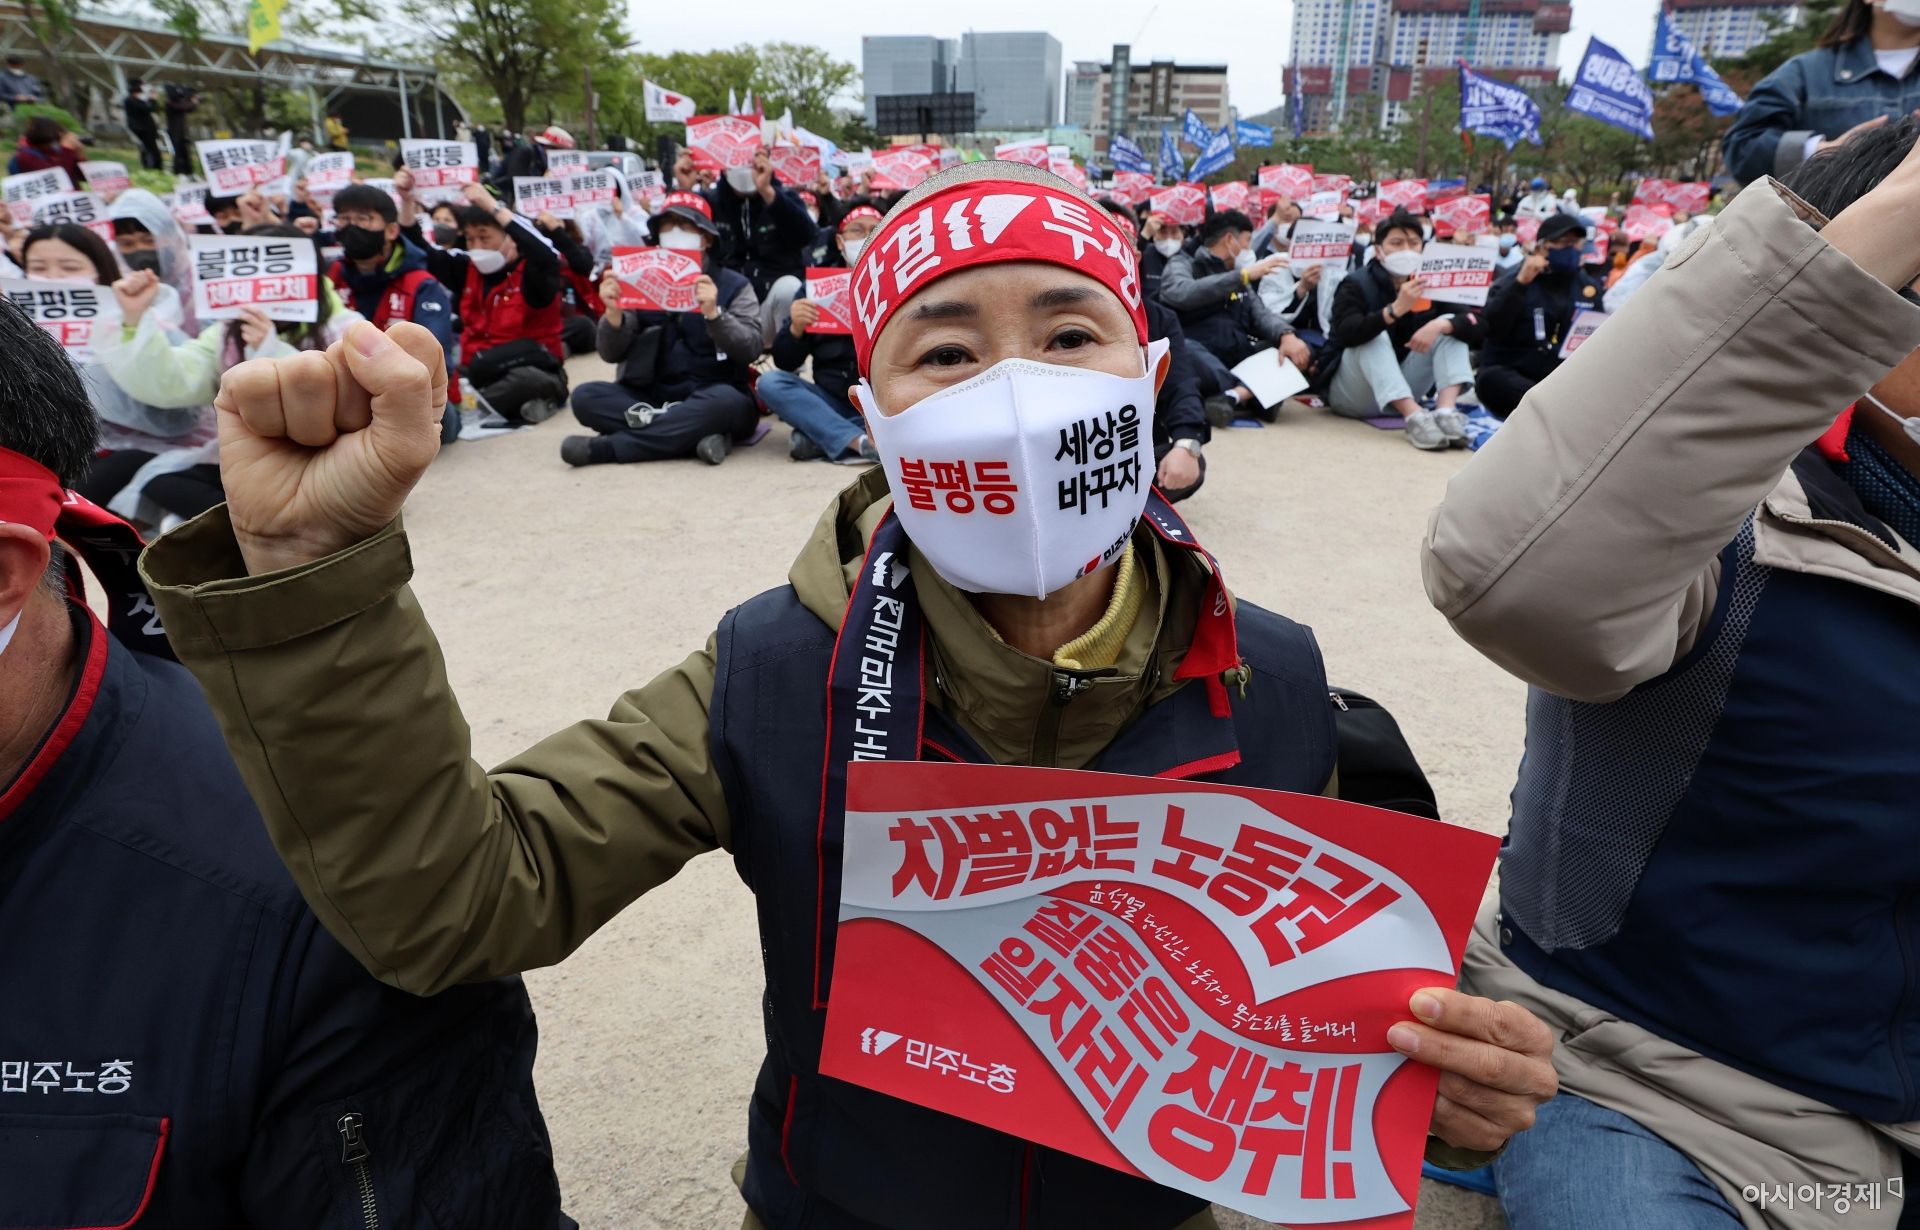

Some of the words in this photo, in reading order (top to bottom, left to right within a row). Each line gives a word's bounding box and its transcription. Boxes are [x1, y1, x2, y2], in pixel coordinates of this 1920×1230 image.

[407, 146, 462, 168] 불평등
[197, 243, 294, 280] 불평등
[257, 276, 307, 301] 교체
[854, 206, 942, 340] 단결
[1042, 196, 1142, 311] 투쟁
[1421, 258, 1466, 272] 비정규직
[1055, 404, 1140, 466] 세상을
[899, 457, 1018, 515] 불평등
[1058, 451, 1141, 515] 바꾸자
[889, 804, 1140, 900] 차별없는
[1152, 804, 1402, 966] 노동권
[1022, 898, 1190, 1061] 질좋은
[1089, 883, 1146, 923] 윤석열
[1142, 914, 1191, 962] 당선인은
[1184, 959, 1232, 1006] 노동자의
[1231, 1003, 1295, 1042] 목소리를
[1299, 1016, 1357, 1043] 들어라!
[905, 1038, 1017, 1094] 민주노총
[979, 936, 1150, 1134] 일자리
[1, 1059, 134, 1095] 민주노총
[1146, 1029, 1362, 1200] 쟁취!
